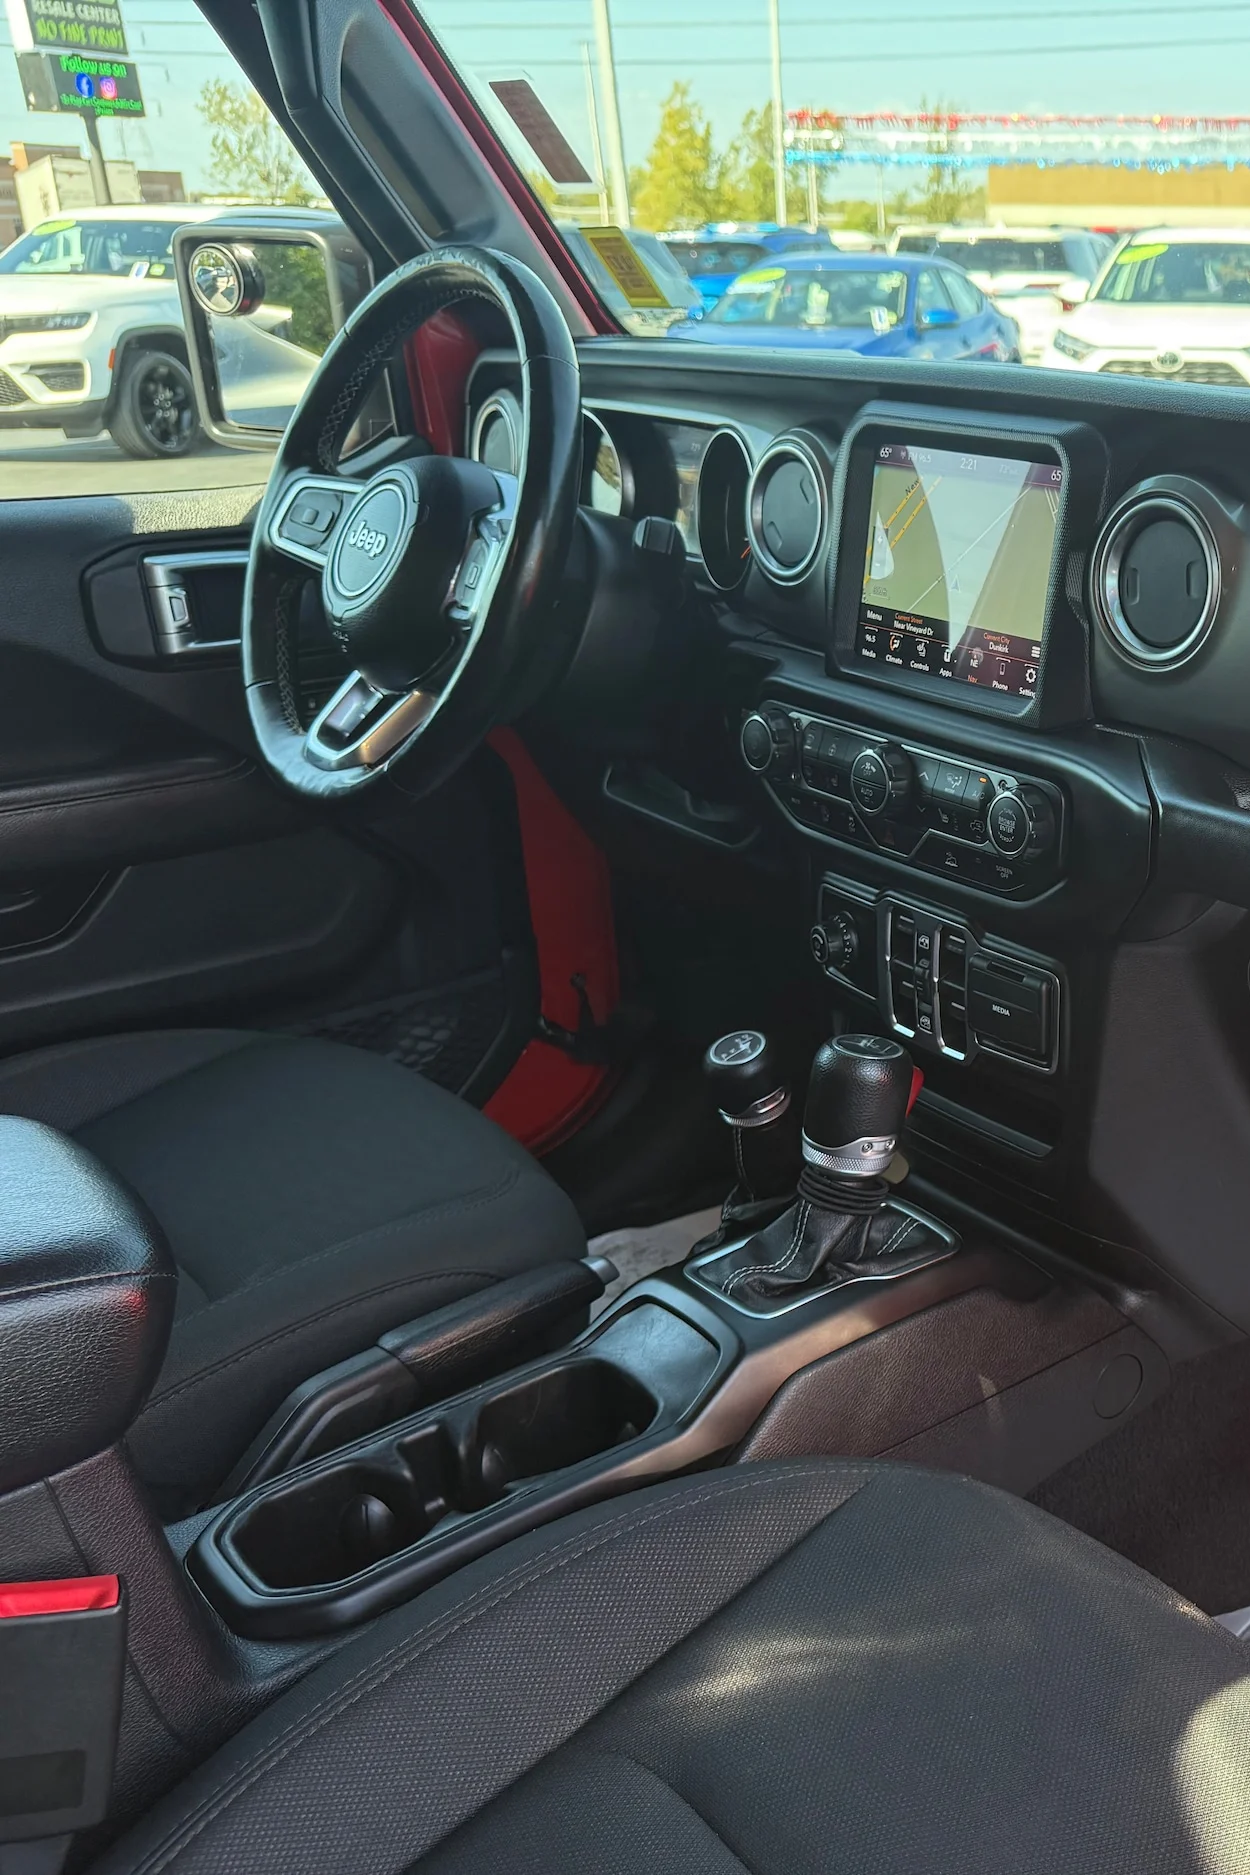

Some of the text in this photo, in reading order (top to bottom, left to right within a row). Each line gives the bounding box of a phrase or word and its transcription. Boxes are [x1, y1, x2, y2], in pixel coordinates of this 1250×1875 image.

[76, 4, 121, 25] CENTER
[36, 18, 124, 48] NO FINE PRINT
[960, 457, 978, 471] 2:21
[350, 520, 387, 560] Jeep
[866, 609, 883, 621] Menu
[893, 620, 934, 636] Near Vineyard Dr
[865, 633, 876, 643] 96.5
[862, 648, 877, 659] Media
[989, 641, 1009, 654] Dunkirk
[885, 654, 903, 665] Climate
[910, 660, 930, 671] Controls
[939, 667, 953, 678] Apps
[967, 674, 979, 683] Nav
[992, 680, 1009, 691] Phone
[1019, 686, 1036, 699] Setting
[860, 786, 874, 797] AUTO
[991, 1004, 1011, 1017] MEDIA
